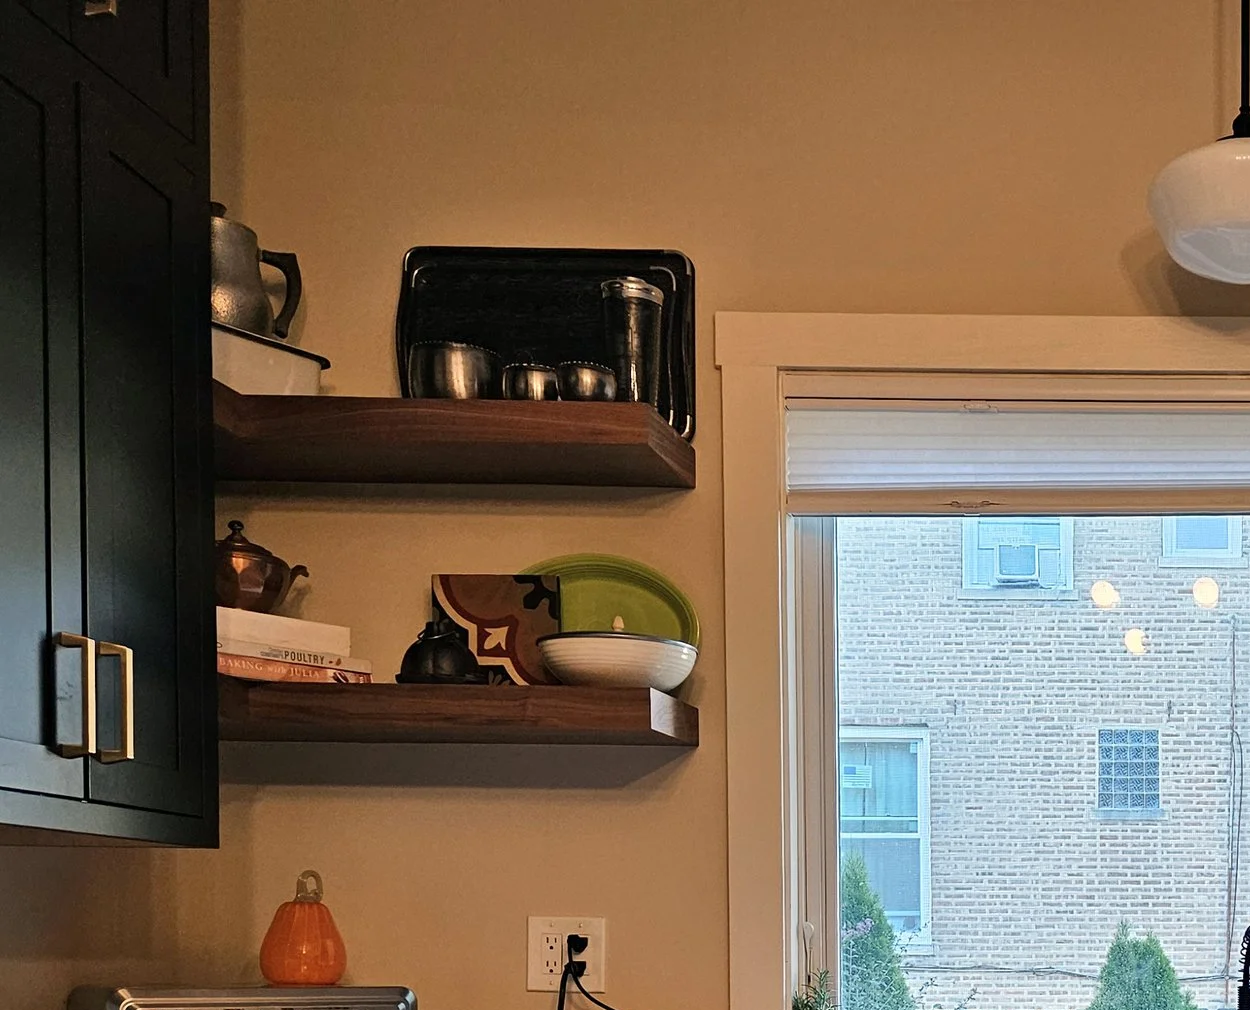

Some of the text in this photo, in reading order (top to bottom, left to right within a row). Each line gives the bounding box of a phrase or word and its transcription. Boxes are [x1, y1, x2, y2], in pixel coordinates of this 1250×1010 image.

[284, 651, 325, 664] POULTRY
[219, 657, 263, 671] BAKING
[290, 668, 320, 678] JULIA
